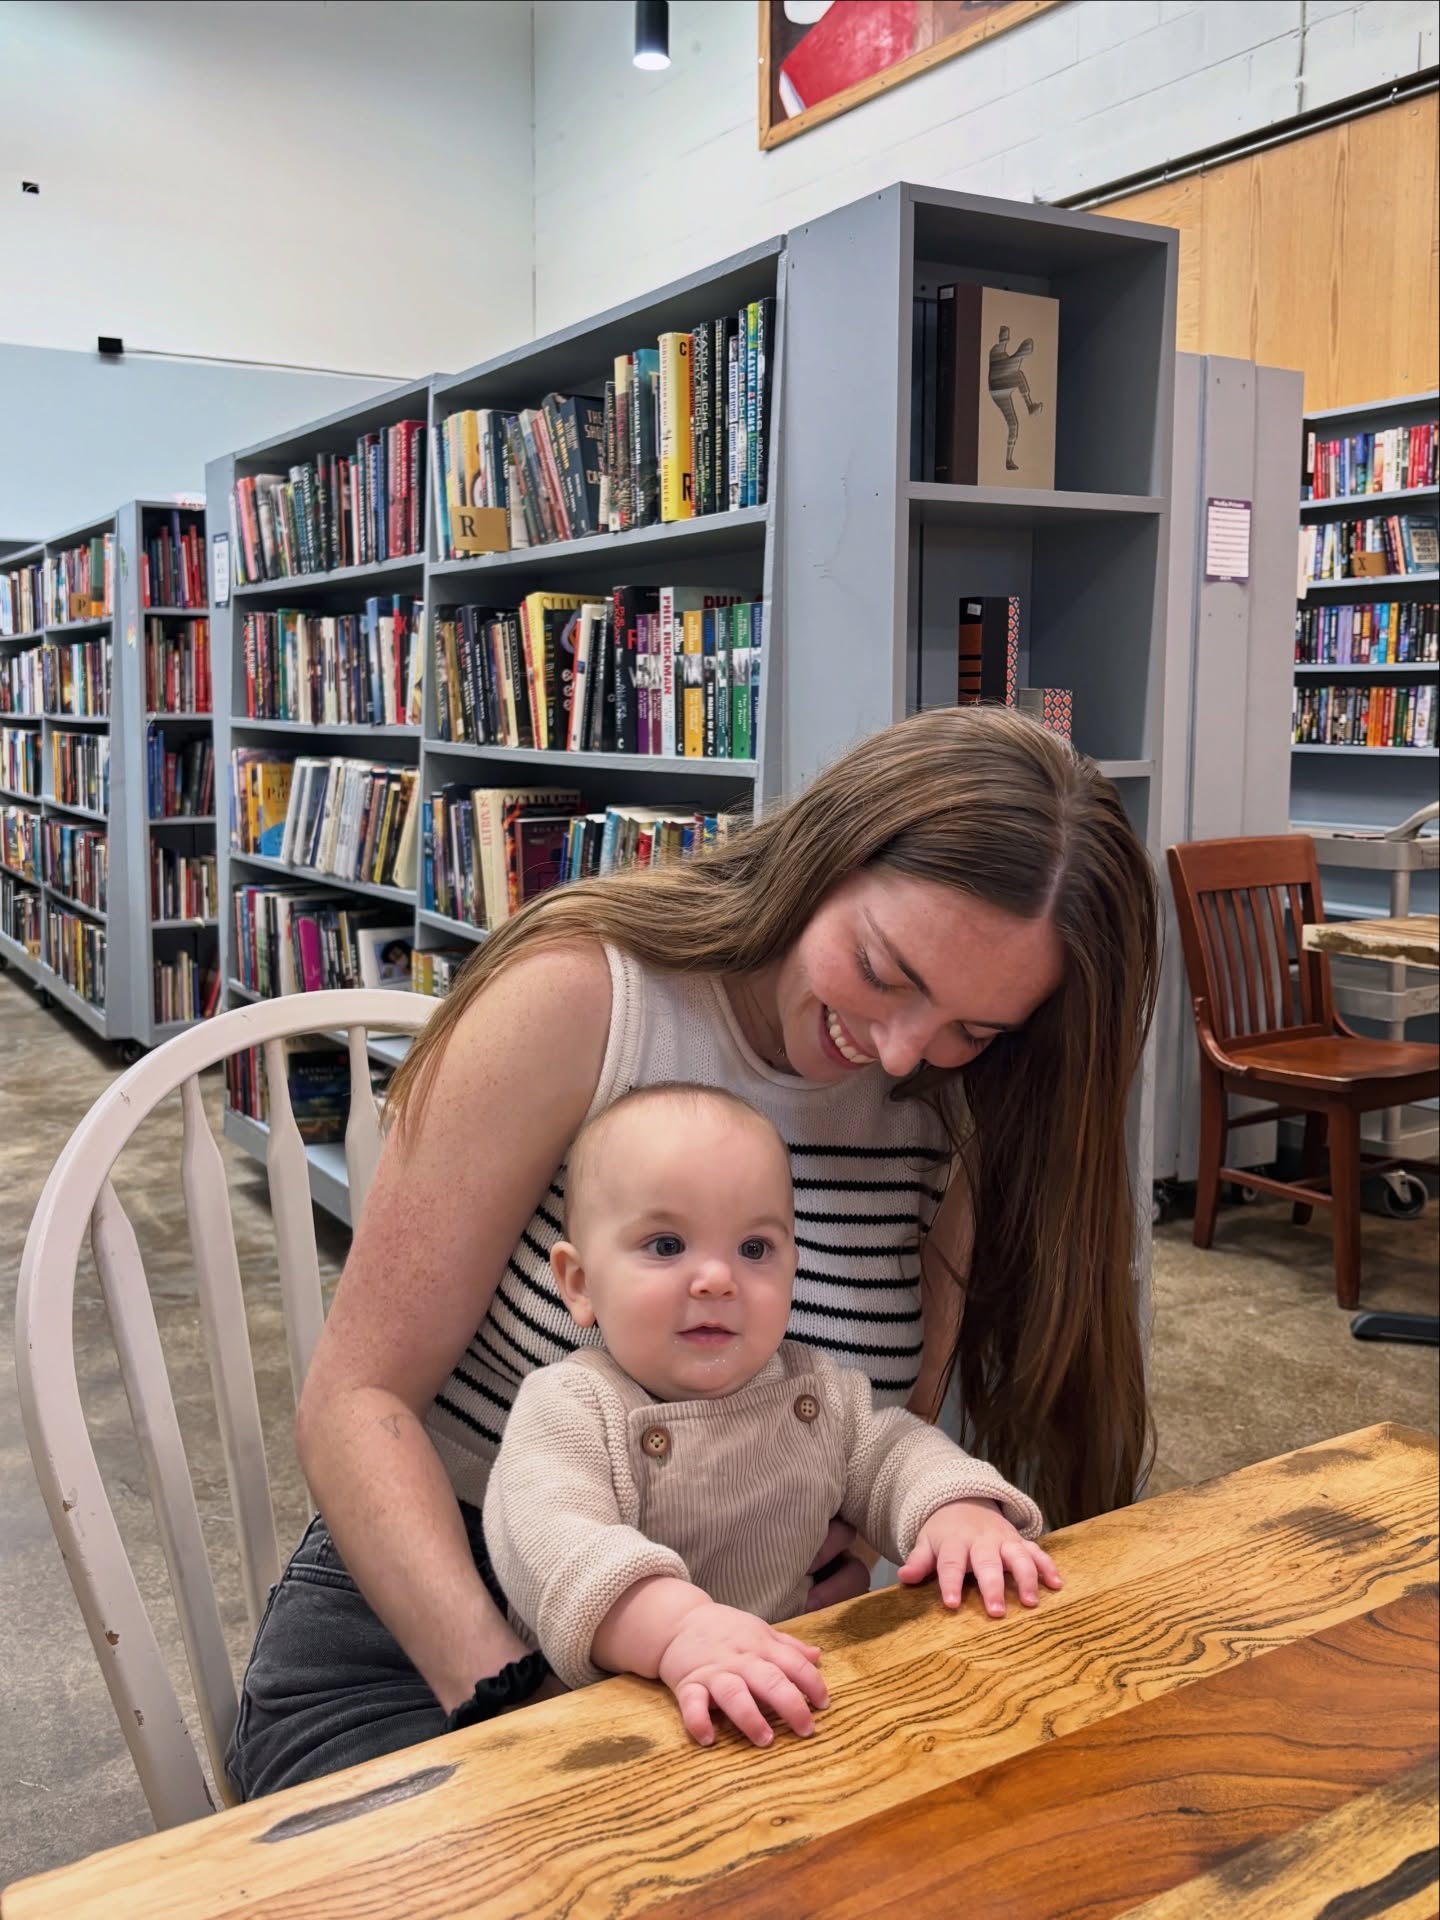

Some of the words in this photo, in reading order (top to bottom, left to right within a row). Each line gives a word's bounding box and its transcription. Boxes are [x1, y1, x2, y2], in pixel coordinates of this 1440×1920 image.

[694, 335, 702, 382] KATHY
[701, 329, 709, 376] KATHY
[748, 350, 756, 386] KATHY
[633, 377, 641, 397] REAL
[729, 363, 737, 389] KATHY
[701, 380, 710, 431] REICHS
[748, 391, 756, 432] REICHS
[634, 437, 642, 465] SWANN
[302, 466, 311, 505] LOUISE
[306, 519, 314, 554] PENNY
[459, 515, 478, 537] R
[662, 595, 672, 629] PHIL
[673, 618, 681, 653] RICKMAN
[662, 631, 672, 695] RICKMAN
[480, 796, 493, 847] SCARLETT
